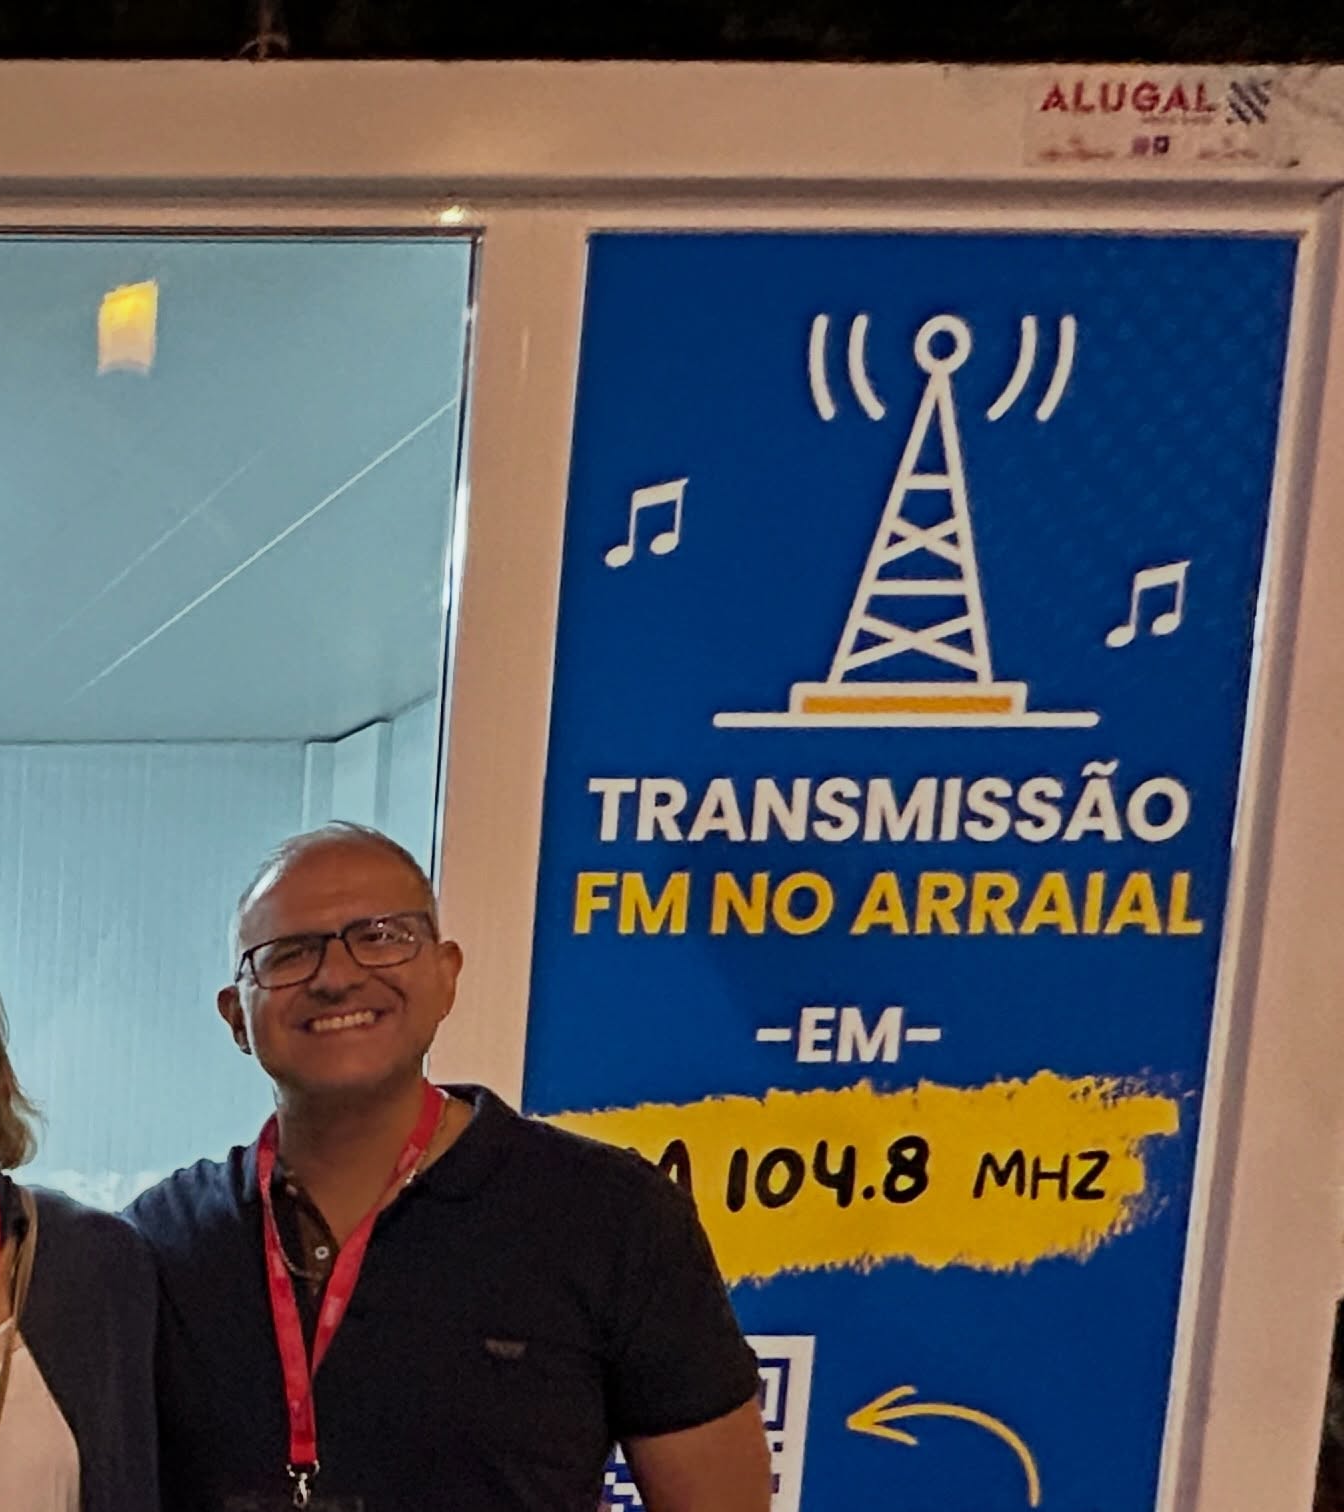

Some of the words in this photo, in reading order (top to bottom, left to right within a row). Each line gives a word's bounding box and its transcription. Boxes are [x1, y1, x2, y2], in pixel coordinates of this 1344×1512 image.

[1040, 80, 1217, 113] ALUGAL
[588, 760, 1190, 842] TRANSMISSÃO
[573, 871, 690, 935] FM
[710, 871, 834, 935] NO
[850, 871, 1203, 935] ARRAIAL
[726, 1136, 929, 1213] 104.8
